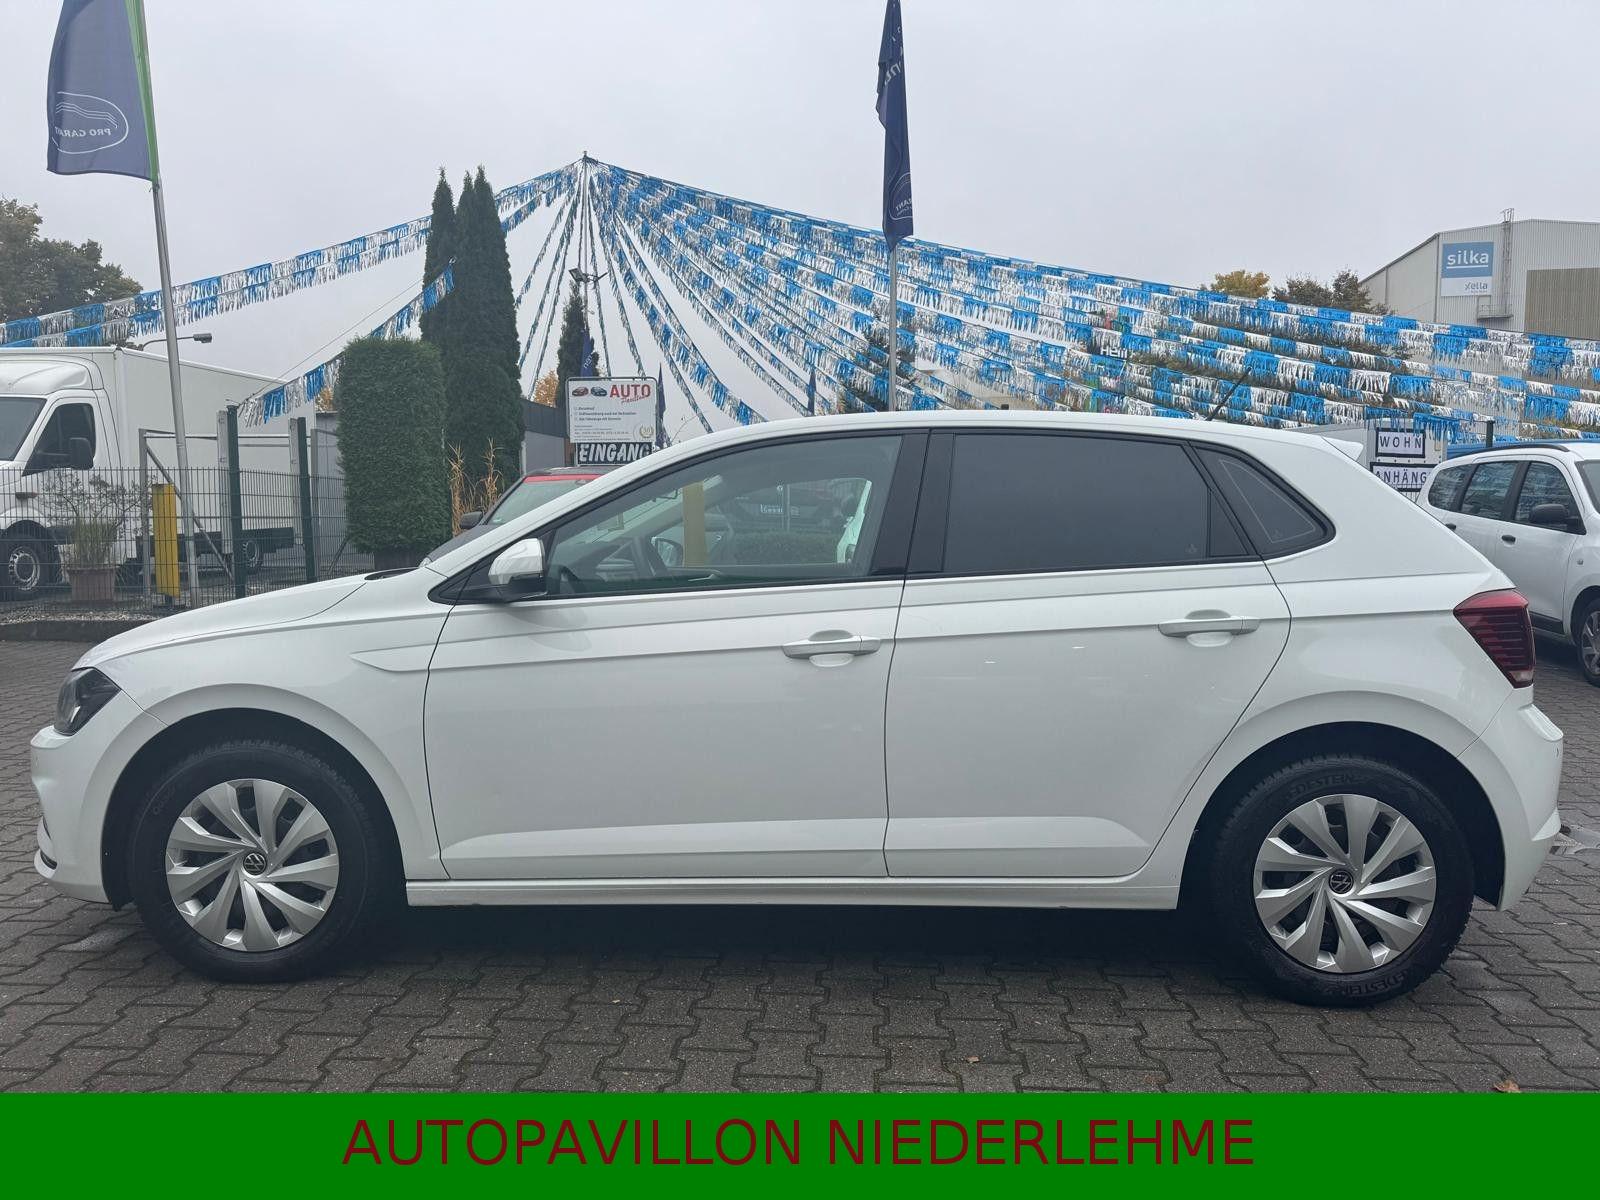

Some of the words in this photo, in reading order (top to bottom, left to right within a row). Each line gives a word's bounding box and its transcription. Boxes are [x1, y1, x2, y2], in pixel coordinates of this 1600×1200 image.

[1447, 250, 1489, 265] silka
[1464, 282, 1488, 290] xella
[610, 384, 651, 398] AUTO
[1380, 436, 1422, 449] WOHN
[579, 443, 650, 462] EINGANG
